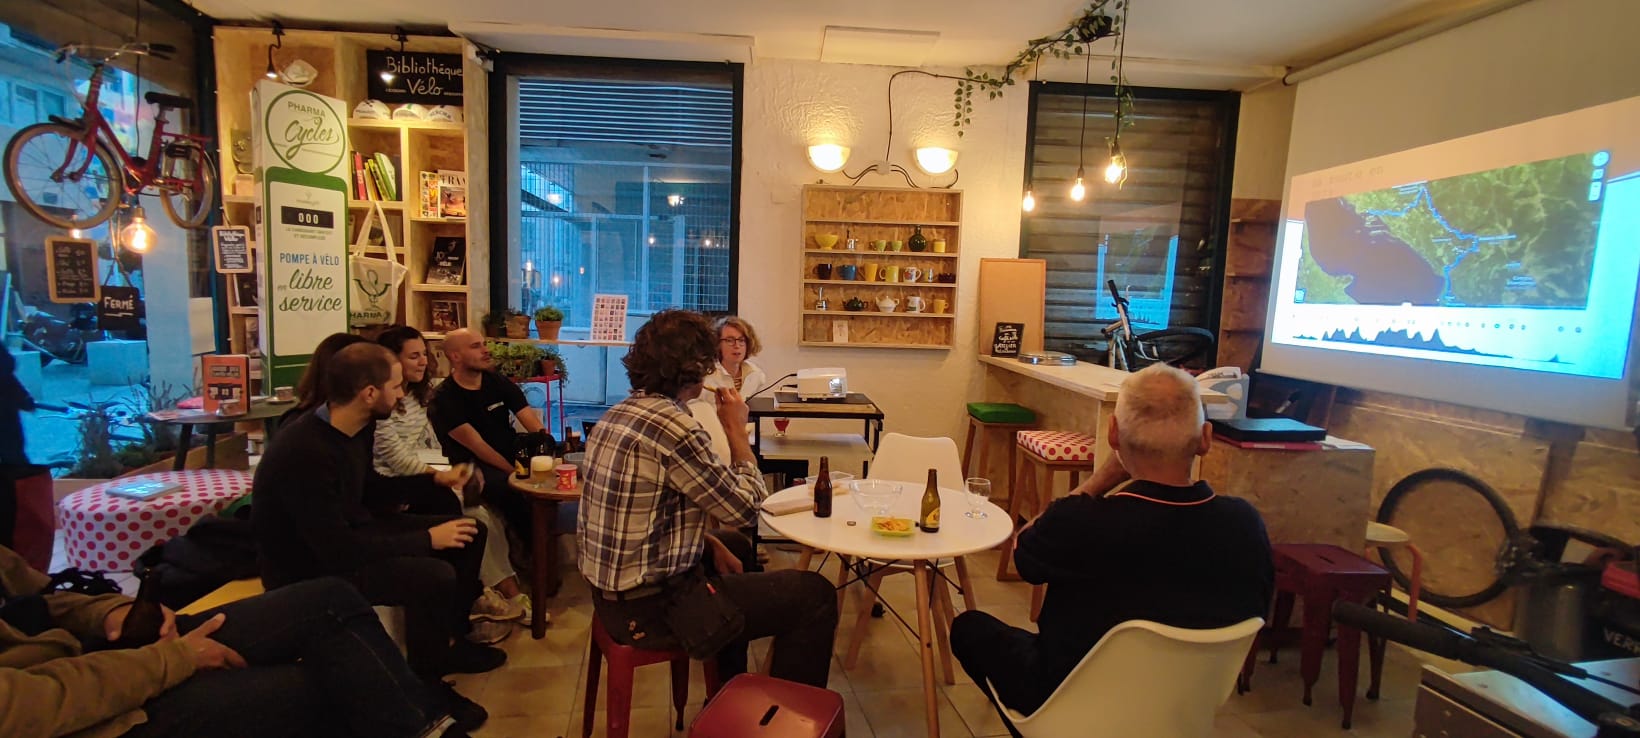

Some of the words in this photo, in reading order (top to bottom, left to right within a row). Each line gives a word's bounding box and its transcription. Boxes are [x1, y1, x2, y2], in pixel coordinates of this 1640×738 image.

[406, 76, 443, 95] Vélo
[287, 101, 326, 117] PHARMA
[284, 117, 339, 160] Cycles
[298, 212, 319, 225] 000
[279, 252, 310, 265] POMPE
[320, 254, 340, 266] VÉLO
[289, 268, 334, 290] libre
[104, 294, 134, 310] FERMÉ
[279, 295, 342, 312] service
[350, 311, 382, 319] HARMA
